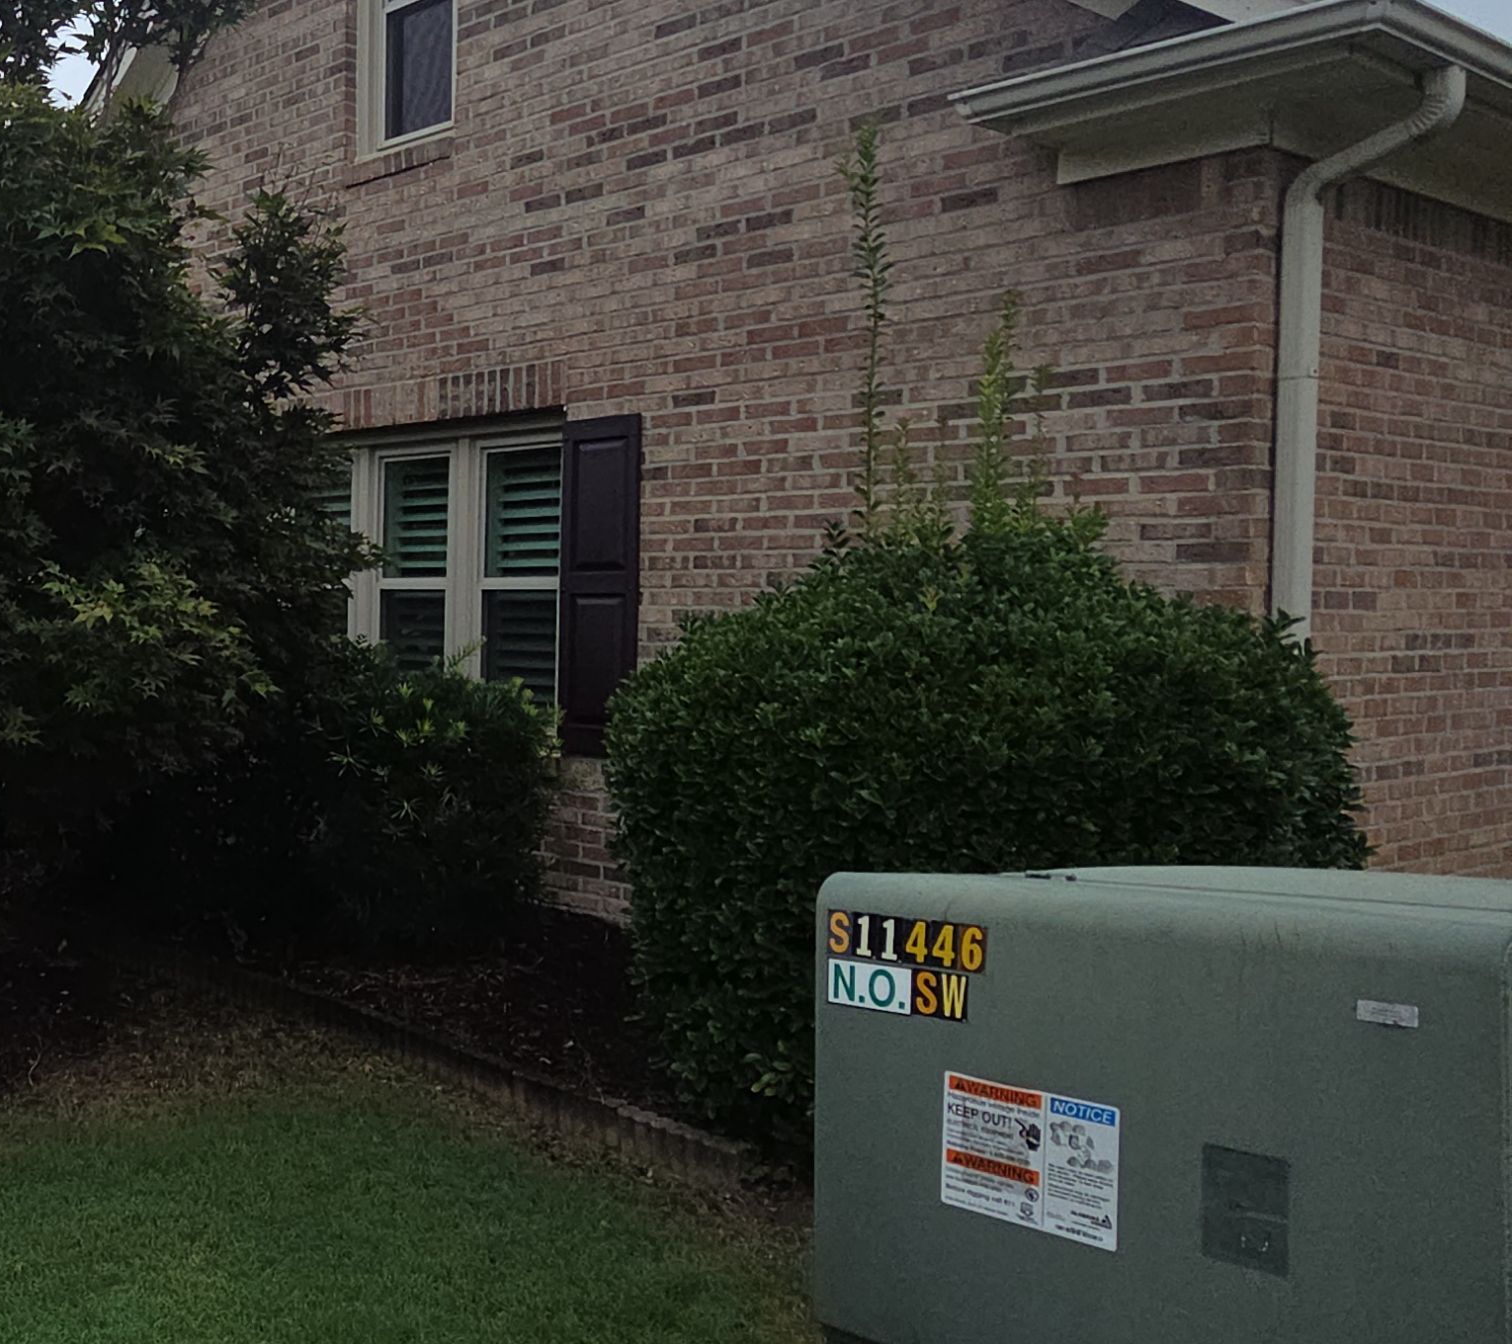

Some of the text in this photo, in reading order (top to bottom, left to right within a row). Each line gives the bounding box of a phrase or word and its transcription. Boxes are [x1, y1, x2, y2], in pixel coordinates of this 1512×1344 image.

[828, 911, 984, 972] S11446
[833, 963, 967, 1020] N.O. SW
[965, 1079, 1036, 1107] WARNING
[947, 1102, 1013, 1129] KEEP OUT!
[1052, 1100, 1113, 1125] NOTICE
[965, 1154, 1034, 1183] WARNING
